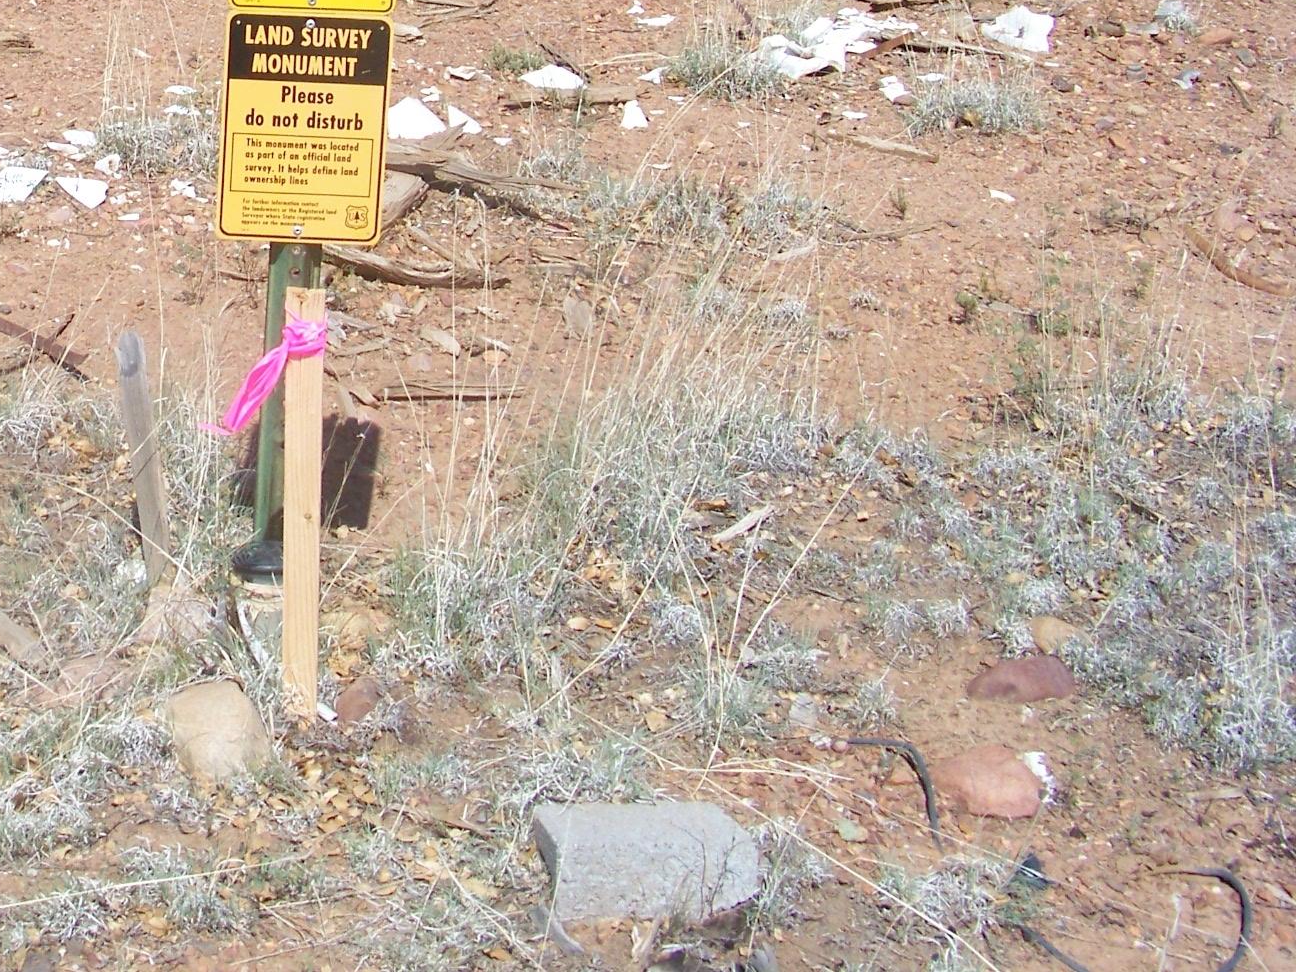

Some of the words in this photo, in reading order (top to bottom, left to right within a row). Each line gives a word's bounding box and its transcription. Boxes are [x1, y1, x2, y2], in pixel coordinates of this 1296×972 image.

[245, 24, 294, 46] LAND
[301, 27, 372, 50] SURVEY
[252, 53, 358, 77] MONUMENT
[281, 85, 334, 104] Please
[245, 108, 264, 126] do
[272, 112, 299, 128] not
[307, 111, 364, 131] disturb
[246, 138, 262, 147] This
[265, 141, 307, 150] monument
[330, 142, 359, 152] located
[257, 152, 274, 160] part
[278, 151, 286, 160] of
[303, 152, 330, 162] official
[334, 154, 352, 162] land
[244, 164, 274, 174] survey.
[278, 164, 284, 172] It
[288, 164, 308, 175] helps
[312, 166, 338, 176] define
[341, 166, 358, 176] land
[244, 176, 286, 186] ownership
[290, 176, 308, 185] lines
